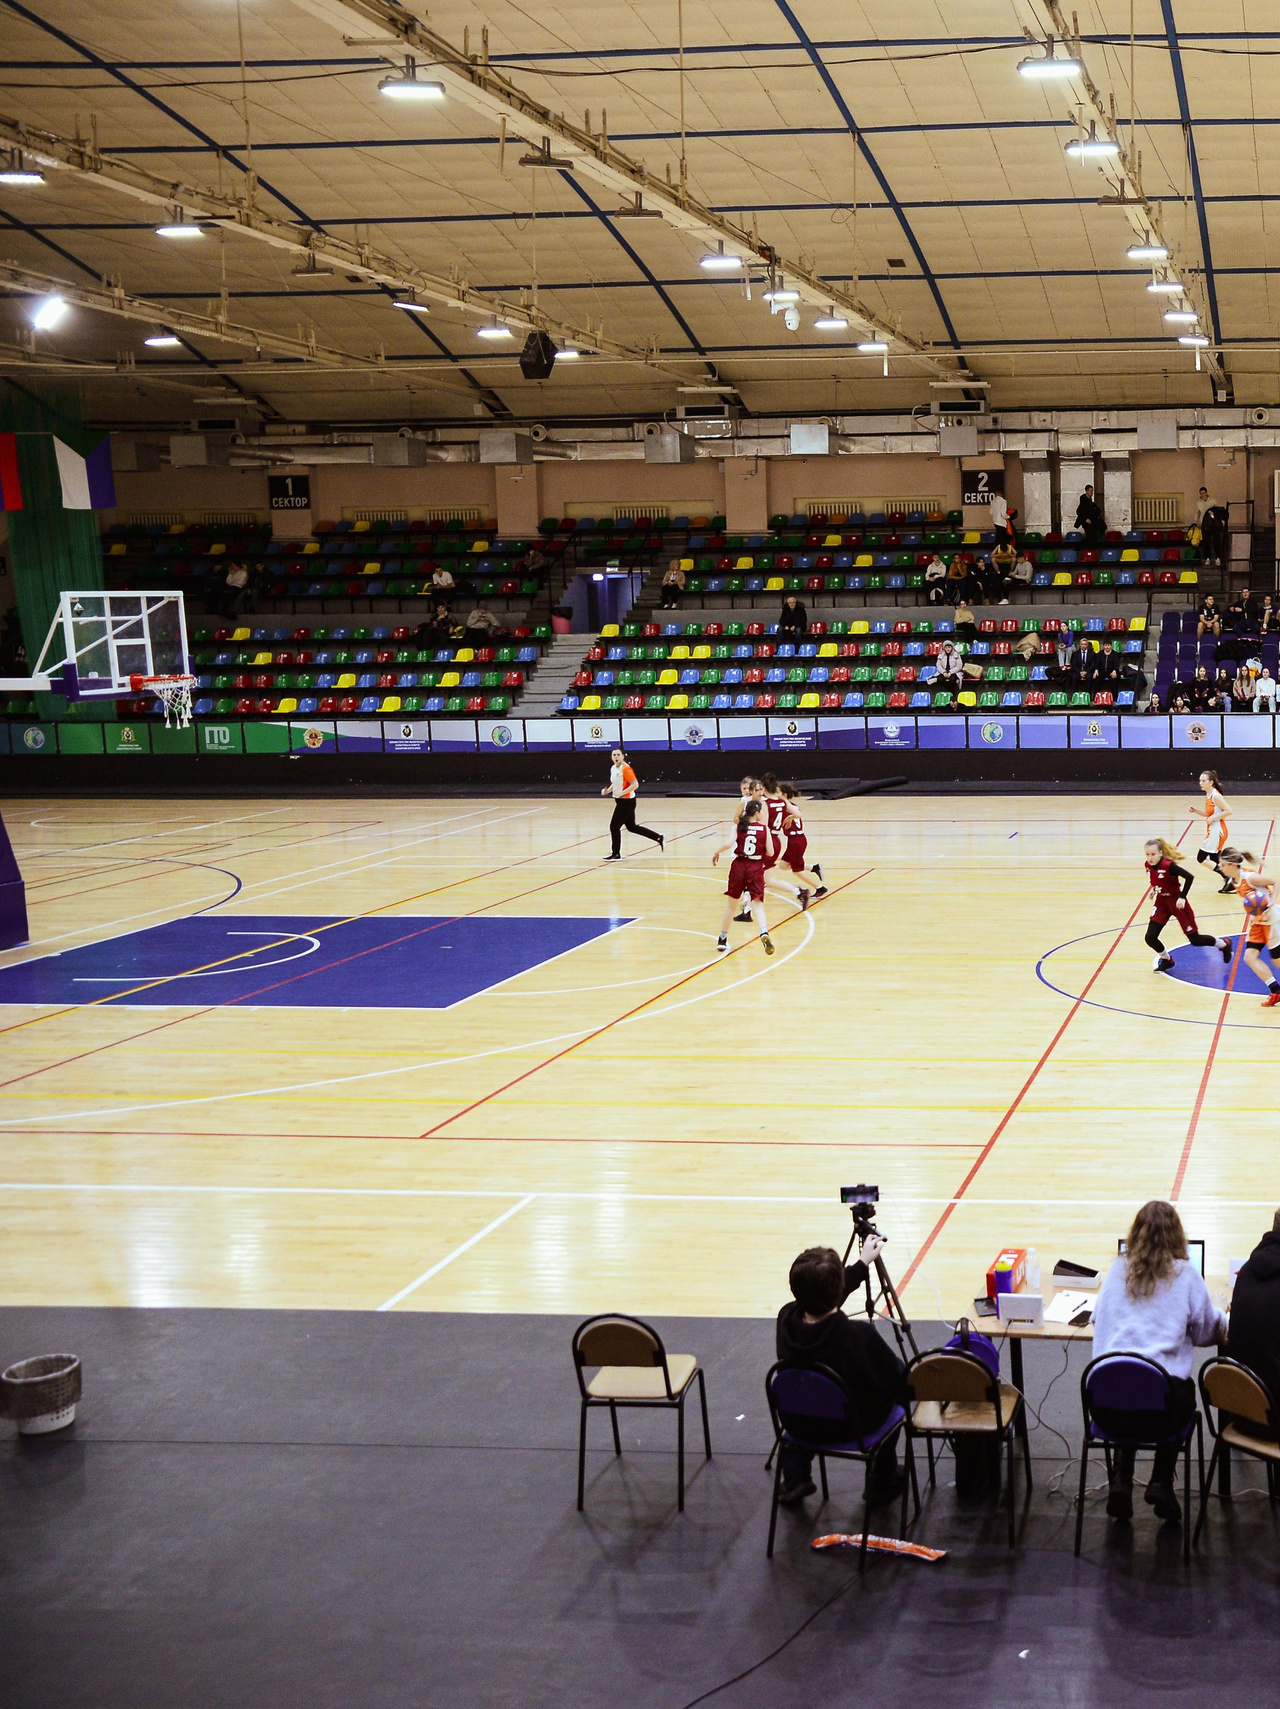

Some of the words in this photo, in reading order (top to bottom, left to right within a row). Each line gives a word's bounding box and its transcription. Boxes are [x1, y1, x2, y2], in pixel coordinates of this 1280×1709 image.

[285, 477, 293, 496] 1
[977, 472, 989, 491] 2
[272, 497, 308, 508] СЕКТОР
[964, 492, 996, 503] СЕКТО
[743, 835, 757, 856] 6
